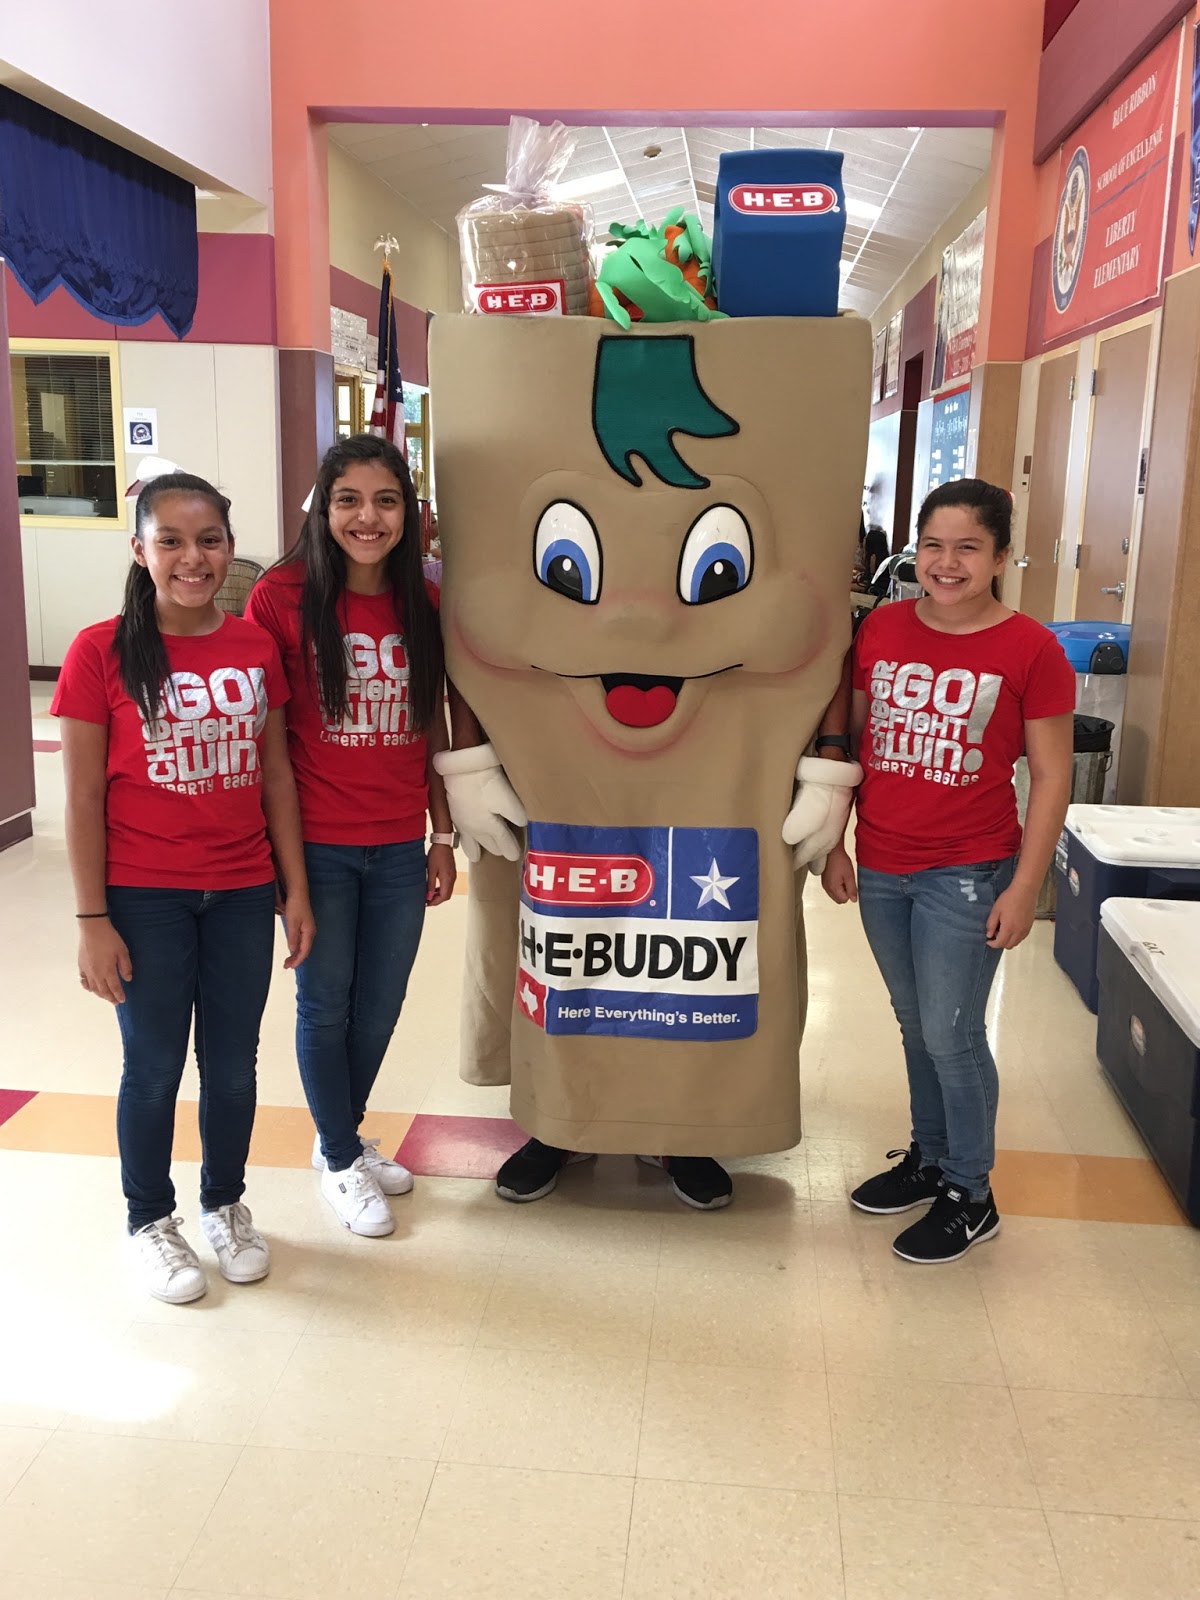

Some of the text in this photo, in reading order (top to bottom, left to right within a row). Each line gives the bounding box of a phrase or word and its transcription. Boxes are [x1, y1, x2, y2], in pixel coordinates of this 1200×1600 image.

[1112, 71, 1158, 130] BLUE RIBBON
[1096, 163, 1118, 193] SCHOOL
[1105, 208, 1137, 249] LIBERTY
[1093, 243, 1142, 290] ELEMENTARY
[172, 715, 256, 747] FIGHT
[888, 707, 969, 741] FIGHT
[557, 1006, 741, 1026] Here Everything's Better.
